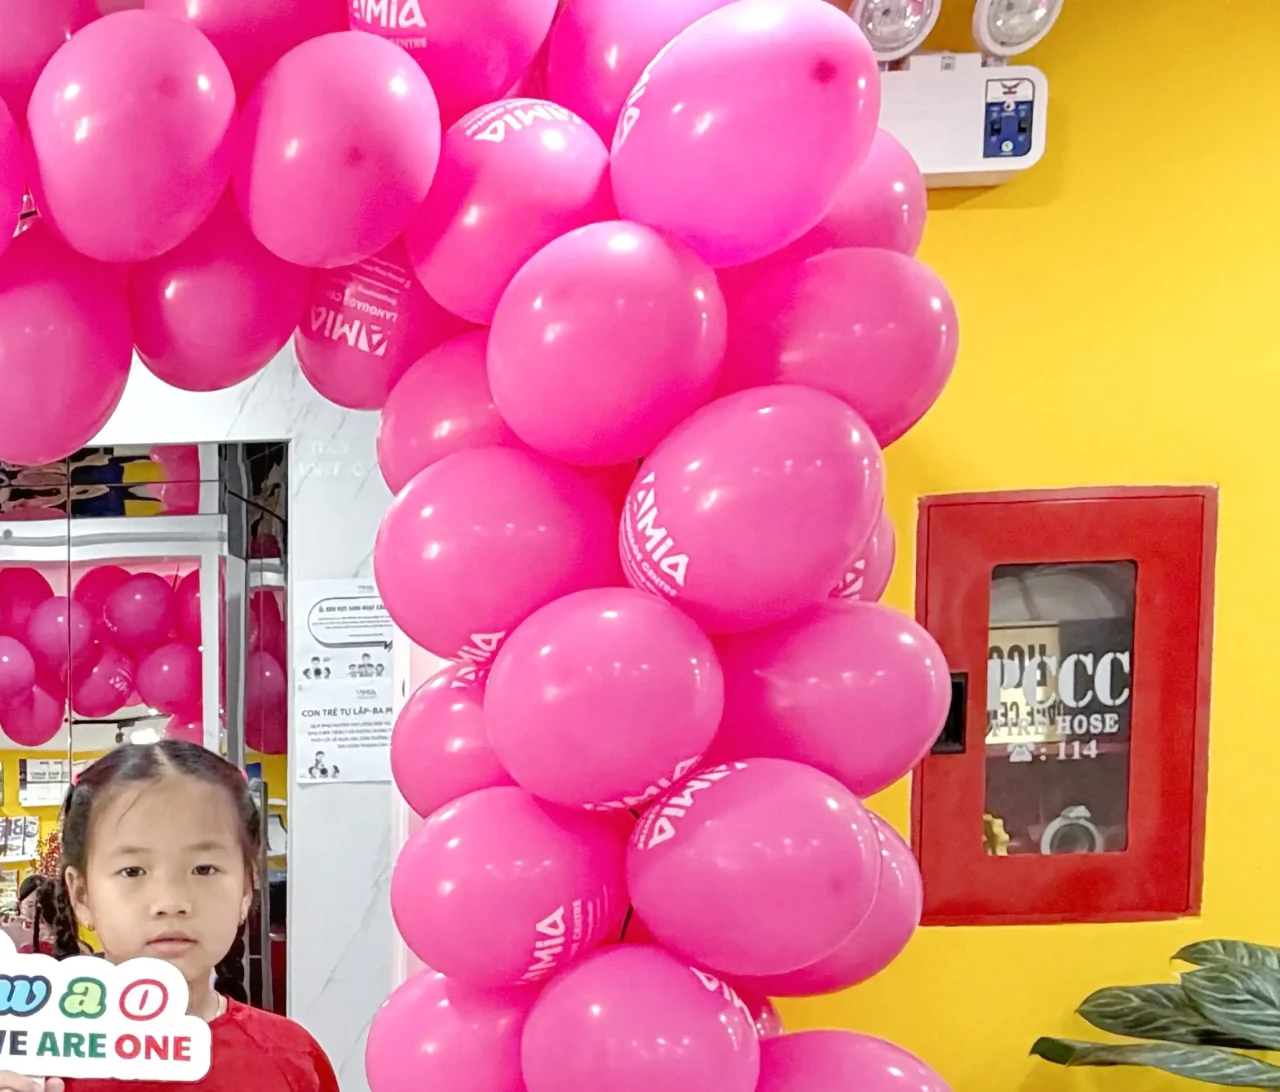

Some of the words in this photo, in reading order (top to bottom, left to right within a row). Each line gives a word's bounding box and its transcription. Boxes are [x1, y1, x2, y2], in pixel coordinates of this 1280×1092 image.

[388, 37, 428, 49] ENTRE
[986, 651, 1130, 712] PCCC
[1055, 713, 1119, 735] HOSE
[1055, 739, 1099, 760] 114
[36, 1032, 107, 1059] ARE
[114, 1034, 192, 1062] ONE
